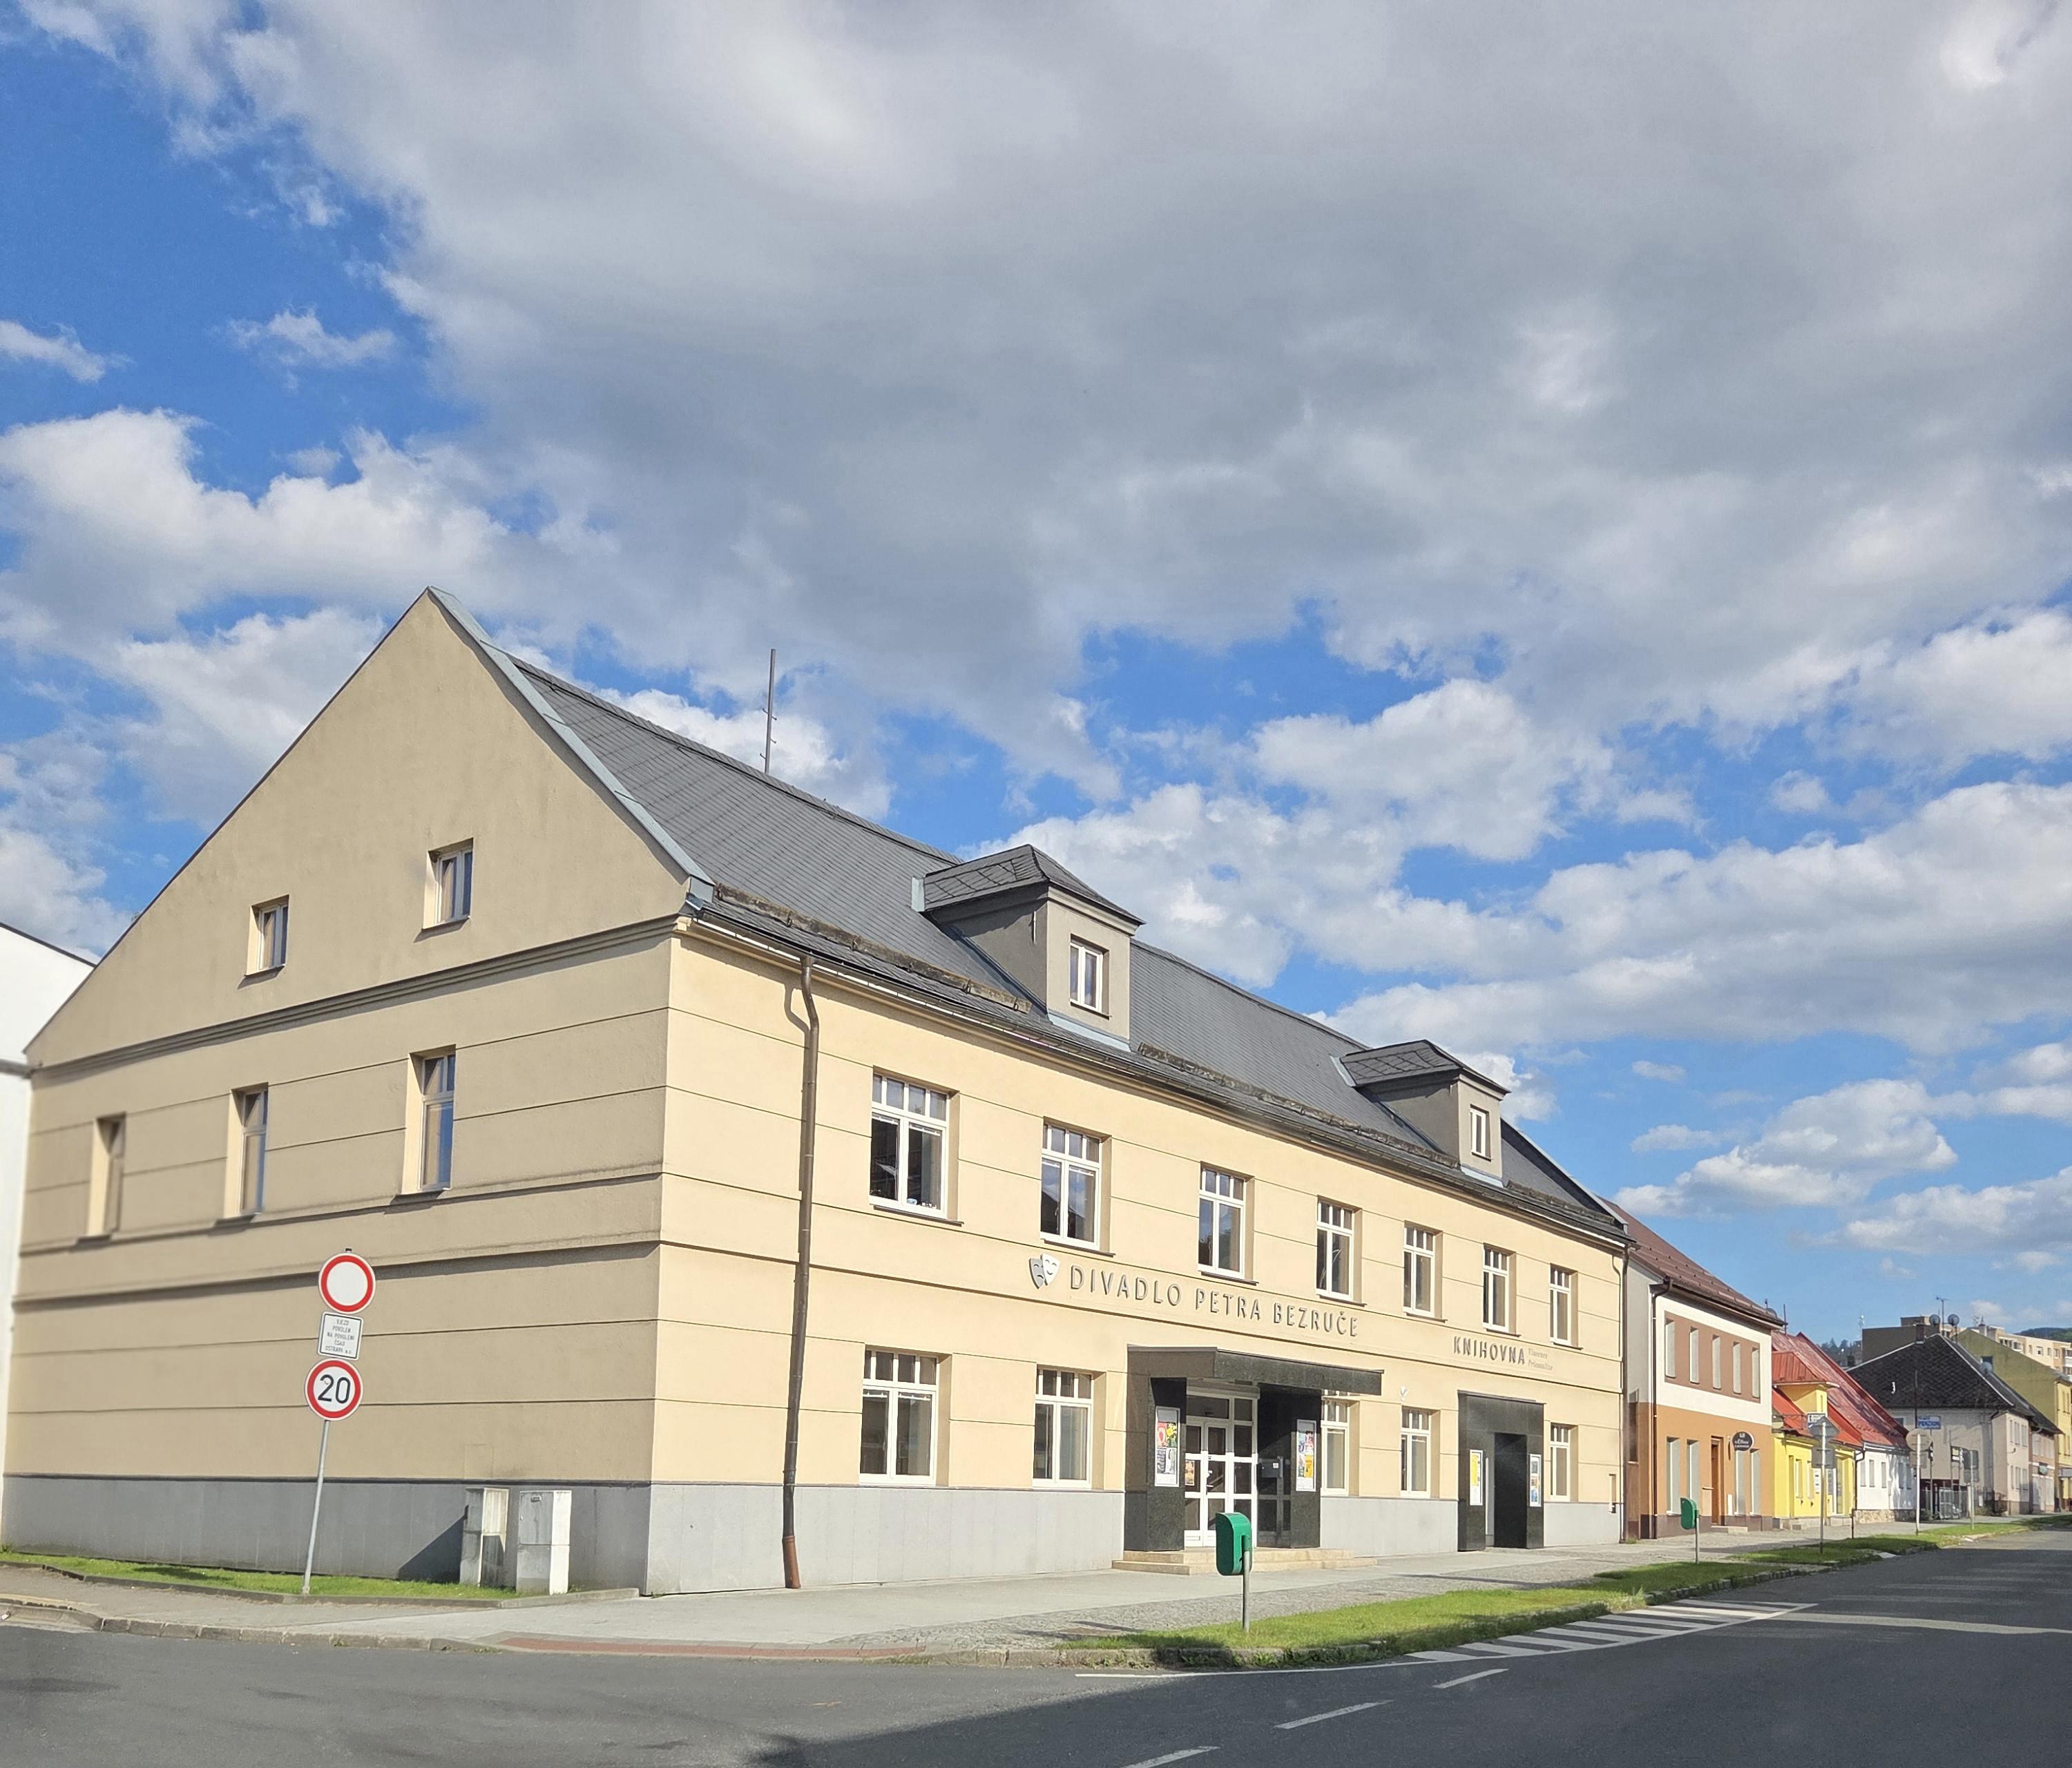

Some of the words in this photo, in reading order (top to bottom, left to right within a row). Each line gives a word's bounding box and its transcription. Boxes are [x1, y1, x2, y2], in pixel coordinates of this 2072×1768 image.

[1071, 1265, 1182, 1306] DIVADLO
[1196, 1288, 1260, 1321] PETRA
[1273, 1302, 1359, 1337] BEZRUČE
[1453, 1336, 1525, 1365] KNIHOVNA
[318, 1374, 351, 1405] 20
